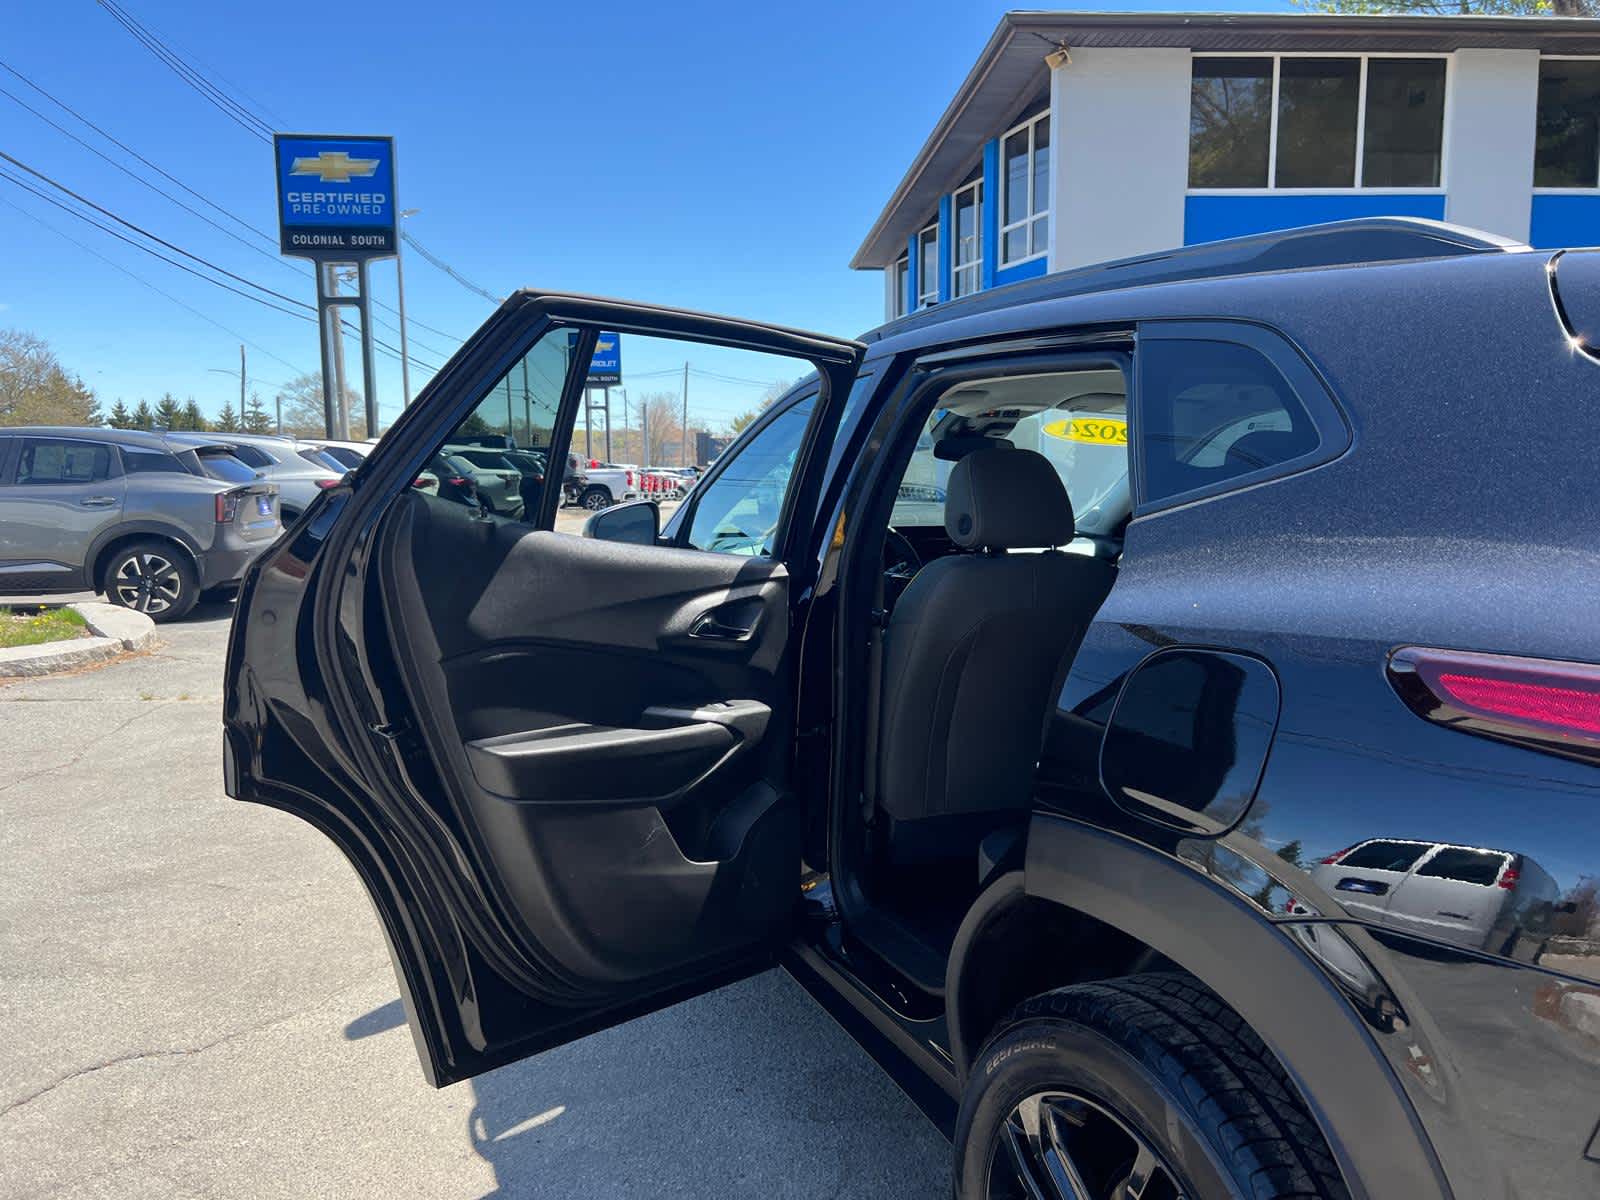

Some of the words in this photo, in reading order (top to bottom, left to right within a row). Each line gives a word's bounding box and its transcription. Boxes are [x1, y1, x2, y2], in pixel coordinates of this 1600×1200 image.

[287, 192, 386, 204] CERTIFIED
[293, 203, 382, 215] PRE-OWNED
[292, 234, 345, 245] COLONIAL
[351, 235, 385, 246] SOUTH
